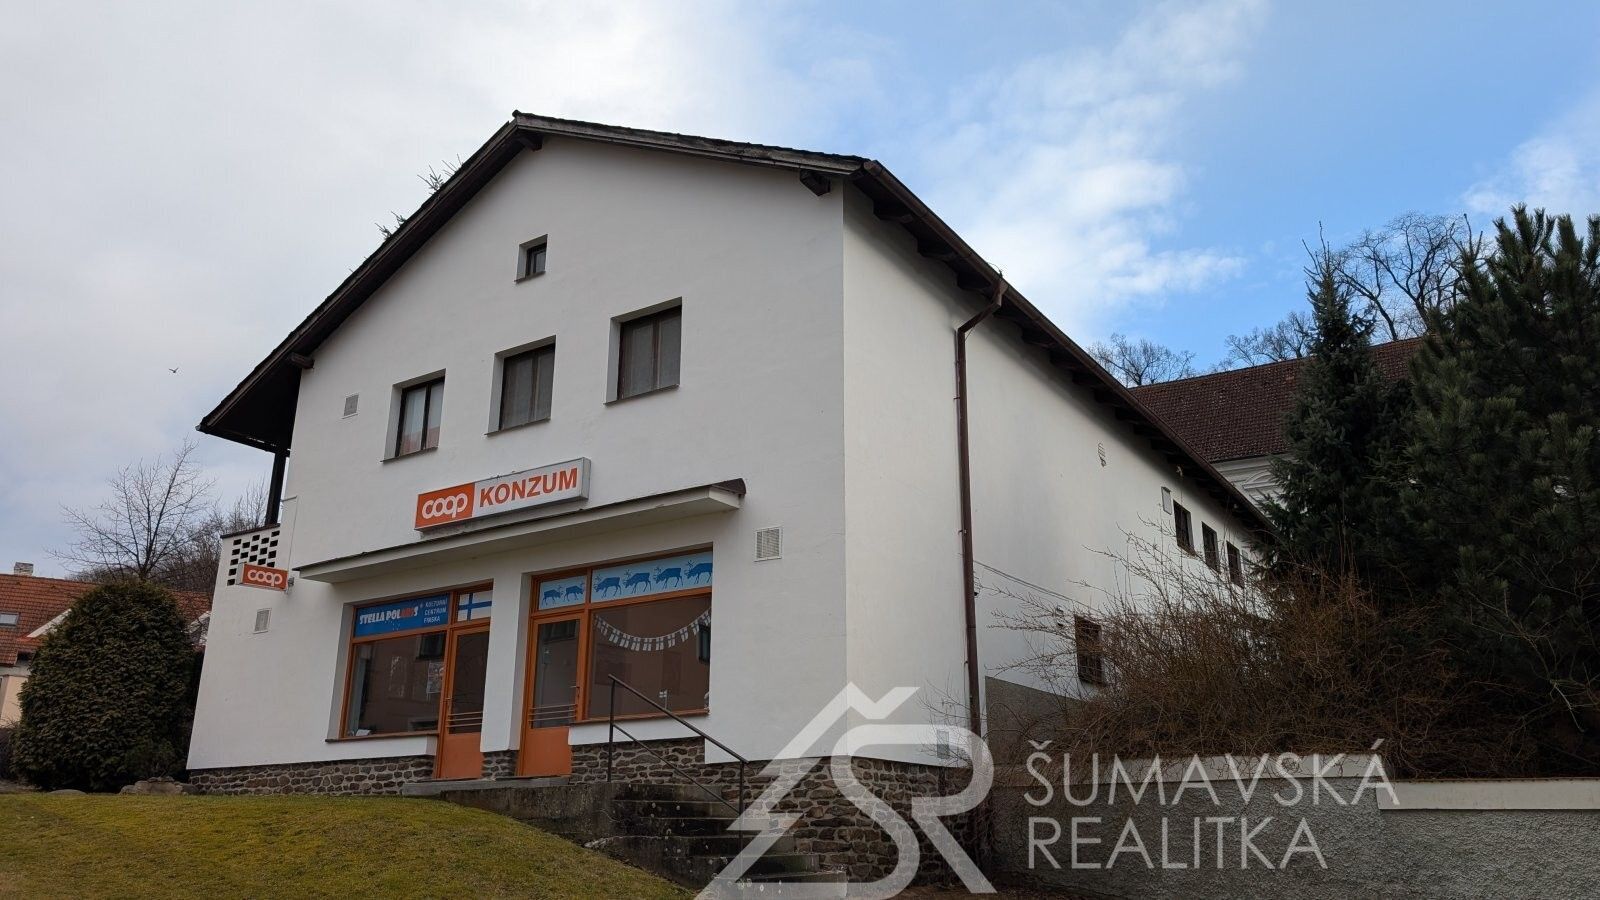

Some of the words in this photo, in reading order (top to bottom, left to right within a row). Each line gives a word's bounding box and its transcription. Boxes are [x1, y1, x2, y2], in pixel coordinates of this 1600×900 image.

[421, 492, 468, 519] coop
[479, 467, 578, 508] KONZUM
[247, 569, 283, 587] coop
[360, 612, 385, 625] STELLA
[424, 606, 447, 616] CENTRUM
